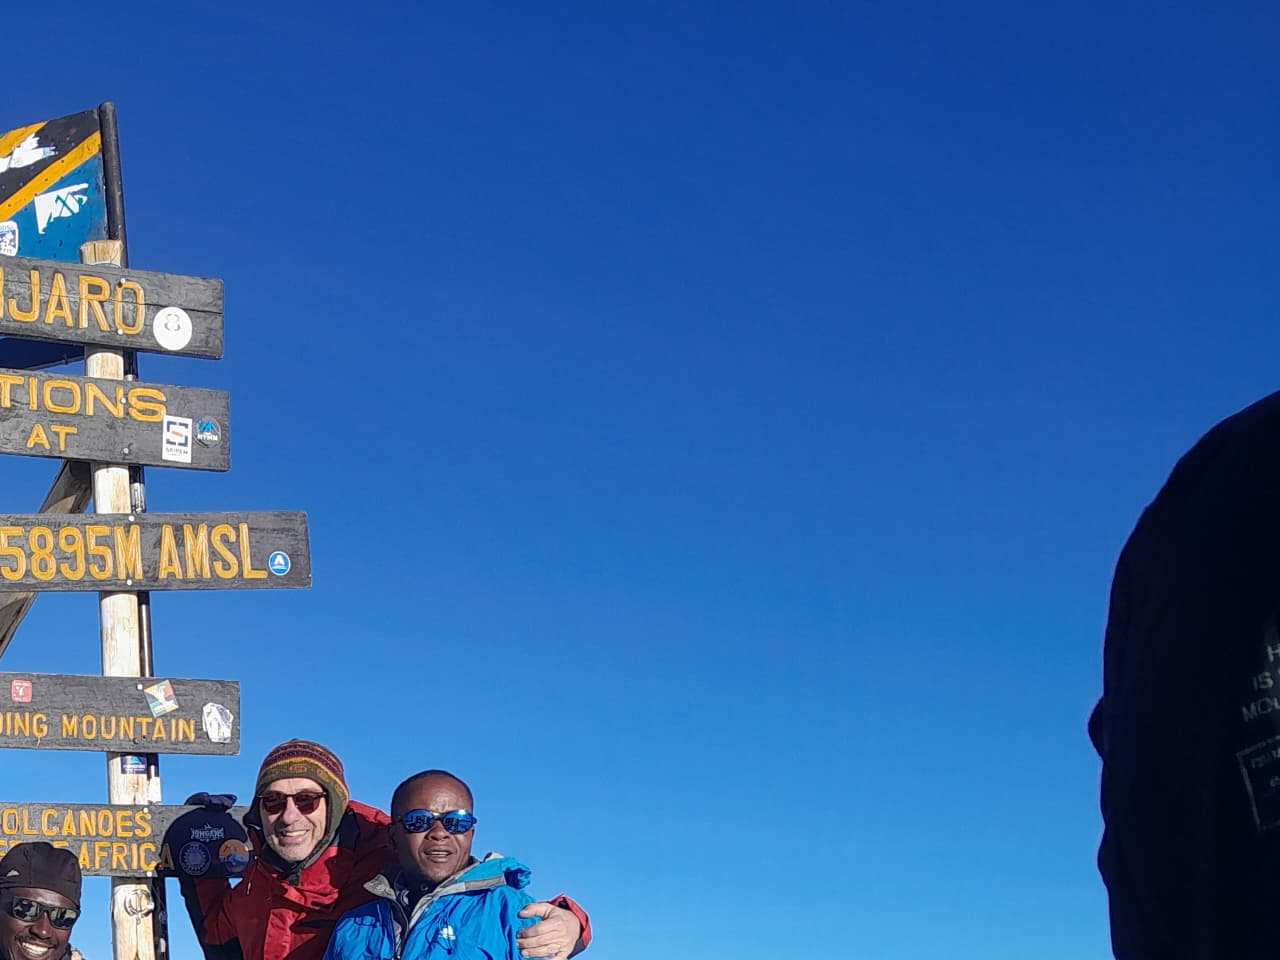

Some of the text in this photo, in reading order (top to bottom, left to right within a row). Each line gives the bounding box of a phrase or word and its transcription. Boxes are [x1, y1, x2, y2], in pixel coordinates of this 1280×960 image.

[26, 424, 77, 451] AT
[158, 523, 268, 579] AMSL
[61, 714, 195, 742] MOUNTAIN
[78, 841, 175, 871] AFRICA
